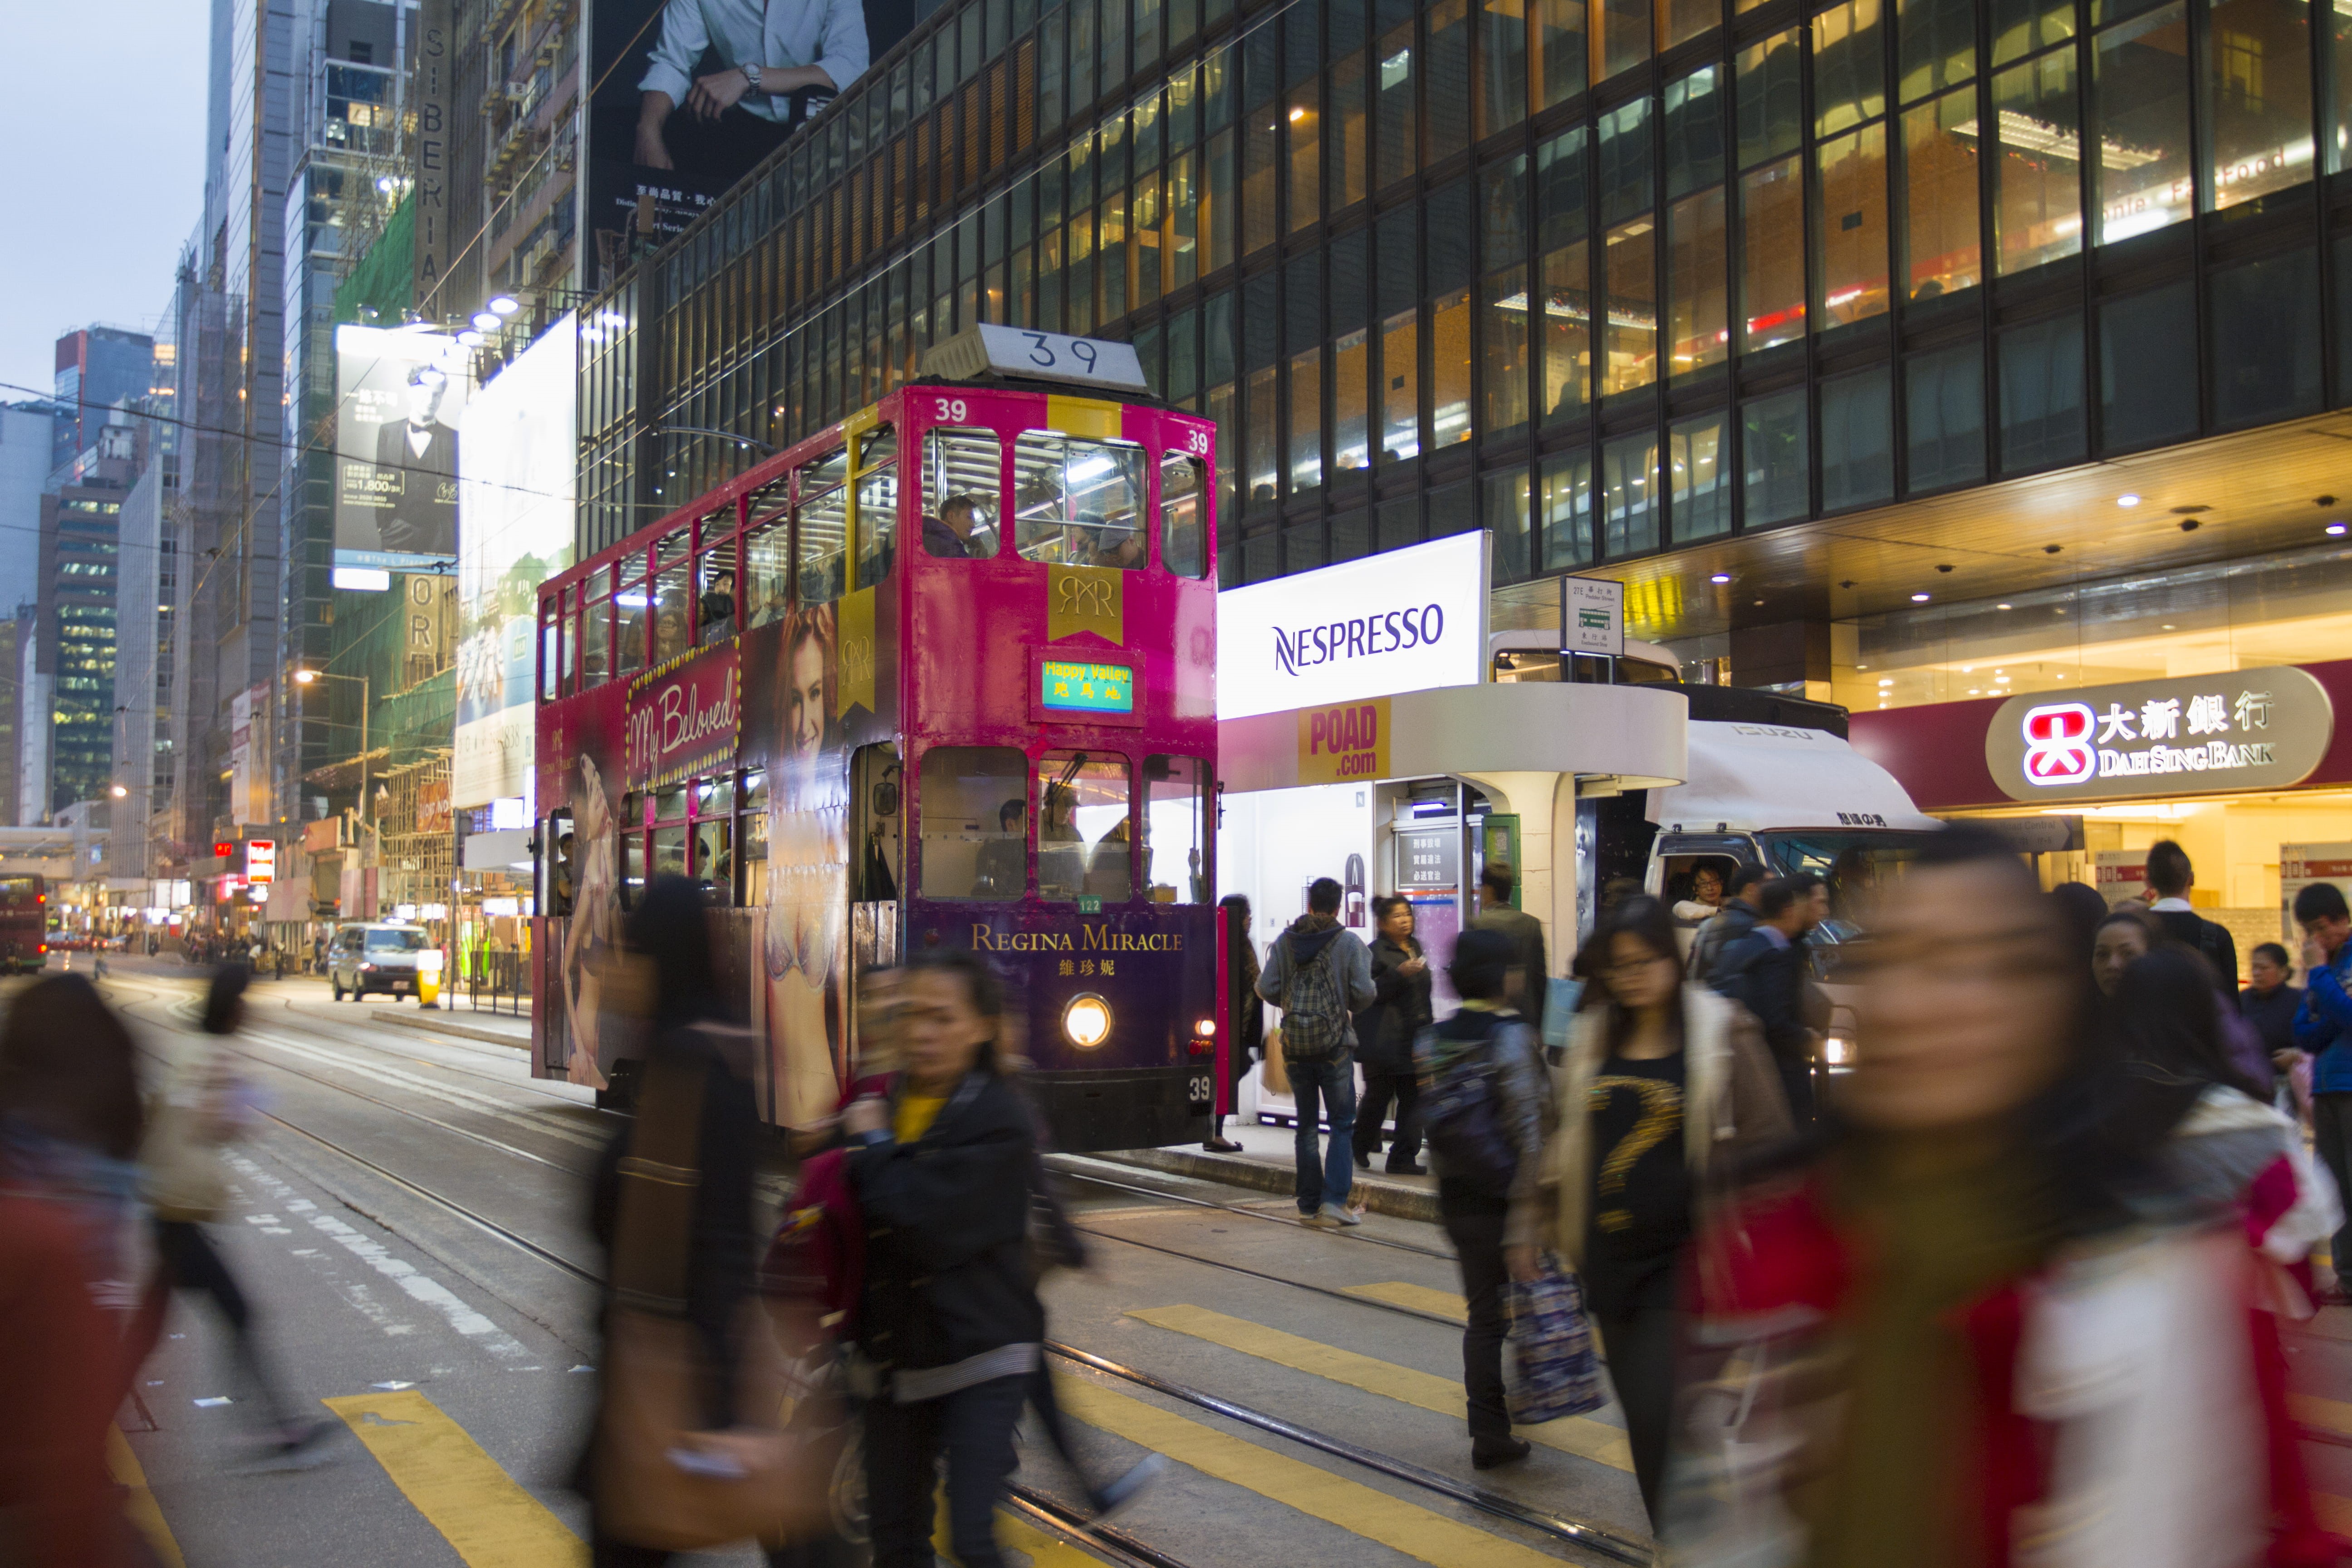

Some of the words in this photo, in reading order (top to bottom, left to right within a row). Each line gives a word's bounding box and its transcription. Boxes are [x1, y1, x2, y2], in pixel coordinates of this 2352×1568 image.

[419, 29, 445, 321] SIBERIAN
[1022, 332, 1097, 374] 39
[935, 398, 967, 422] 39
[1188, 430, 1208, 454] 39
[1573, 587, 1583, 595] 27E
[1272, 604, 1444, 676] NESPRESSO
[1045, 662, 1086, 681] Happy
[1091, 664, 1129, 684] Valley
[1054, 681, 1121, 700] 跑馬地
[630, 705, 659, 783] My
[658, 666, 735, 754] Beloved
[2097, 691, 2274, 744] 大新銀行
[1310, 705, 1377, 755] POAD
[1336, 751, 1377, 776] .com
[1080, 900, 1099, 911] 122
[970, 923, 1074, 951] REGINA
[1081, 924, 1182, 951] MIRACLE
[1059, 959, 1115, 976] 維珍妮
[1189, 1077, 1210, 1100] 39
